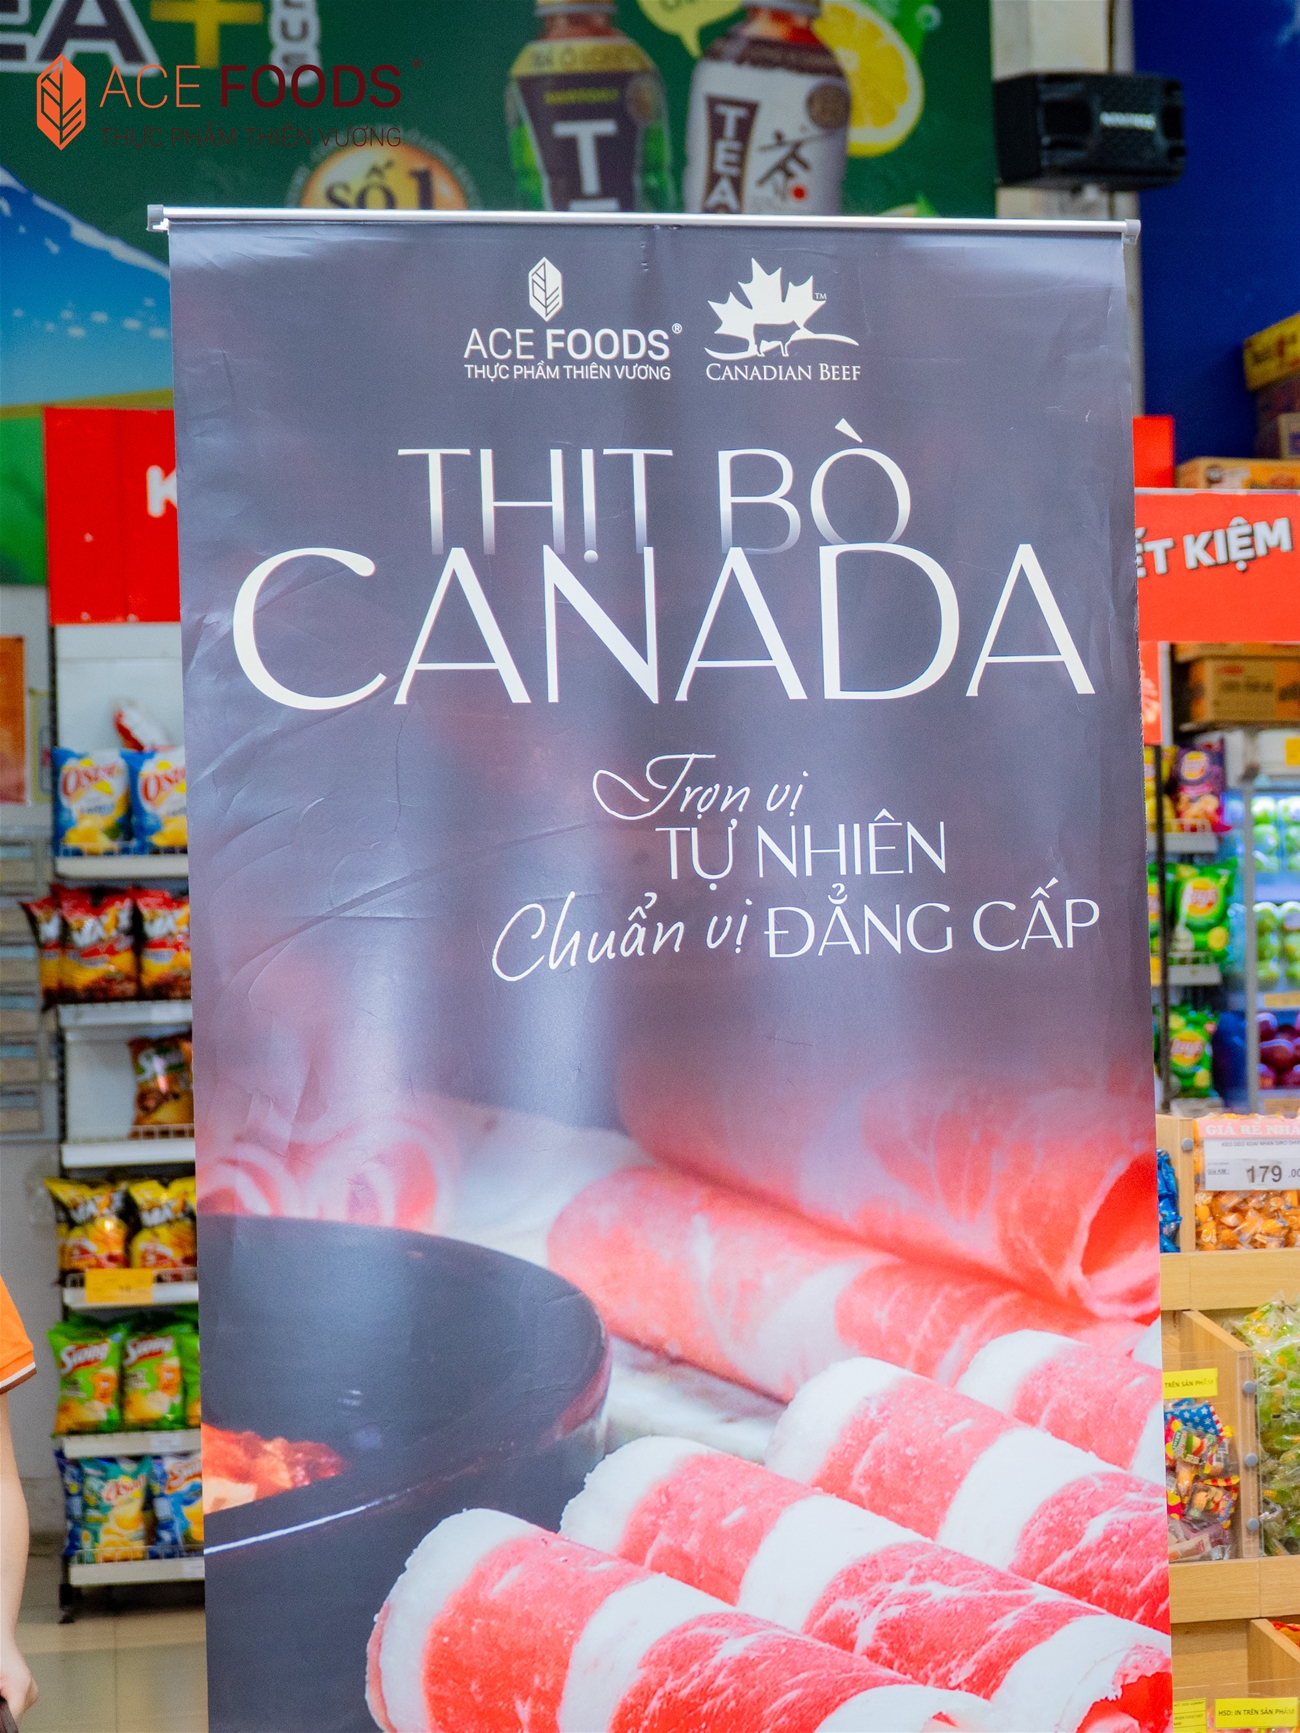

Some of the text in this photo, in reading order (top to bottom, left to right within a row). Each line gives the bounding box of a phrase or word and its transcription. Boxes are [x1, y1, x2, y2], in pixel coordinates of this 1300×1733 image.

[702, 103, 748, 212] TEA
[463, 328, 670, 361] ACE FOODS
[464, 359, 671, 381] THỰC PHẨM THIÊN VƯƠNG
[705, 362, 861, 381] CANADIAN BEEF
[396, 417, 911, 563] THỊT BÒ
[1183, 515, 1294, 573] KIỆM
[231, 542, 1096, 711] CANADA
[592, 752, 809, 820] Trọn vị
[655, 808, 947, 891] TỰ NHIÊN
[491, 876, 1101, 982] Chuẩn vị ĐẲNG CẤP
[1205, 1122, 1236, 1135] GIÁ
[1245, 1164, 1283, 1184] 179
[1243, 1707, 1259, 1716] TRÊN
[1260, 1707, 1273, 1716] SẢN
